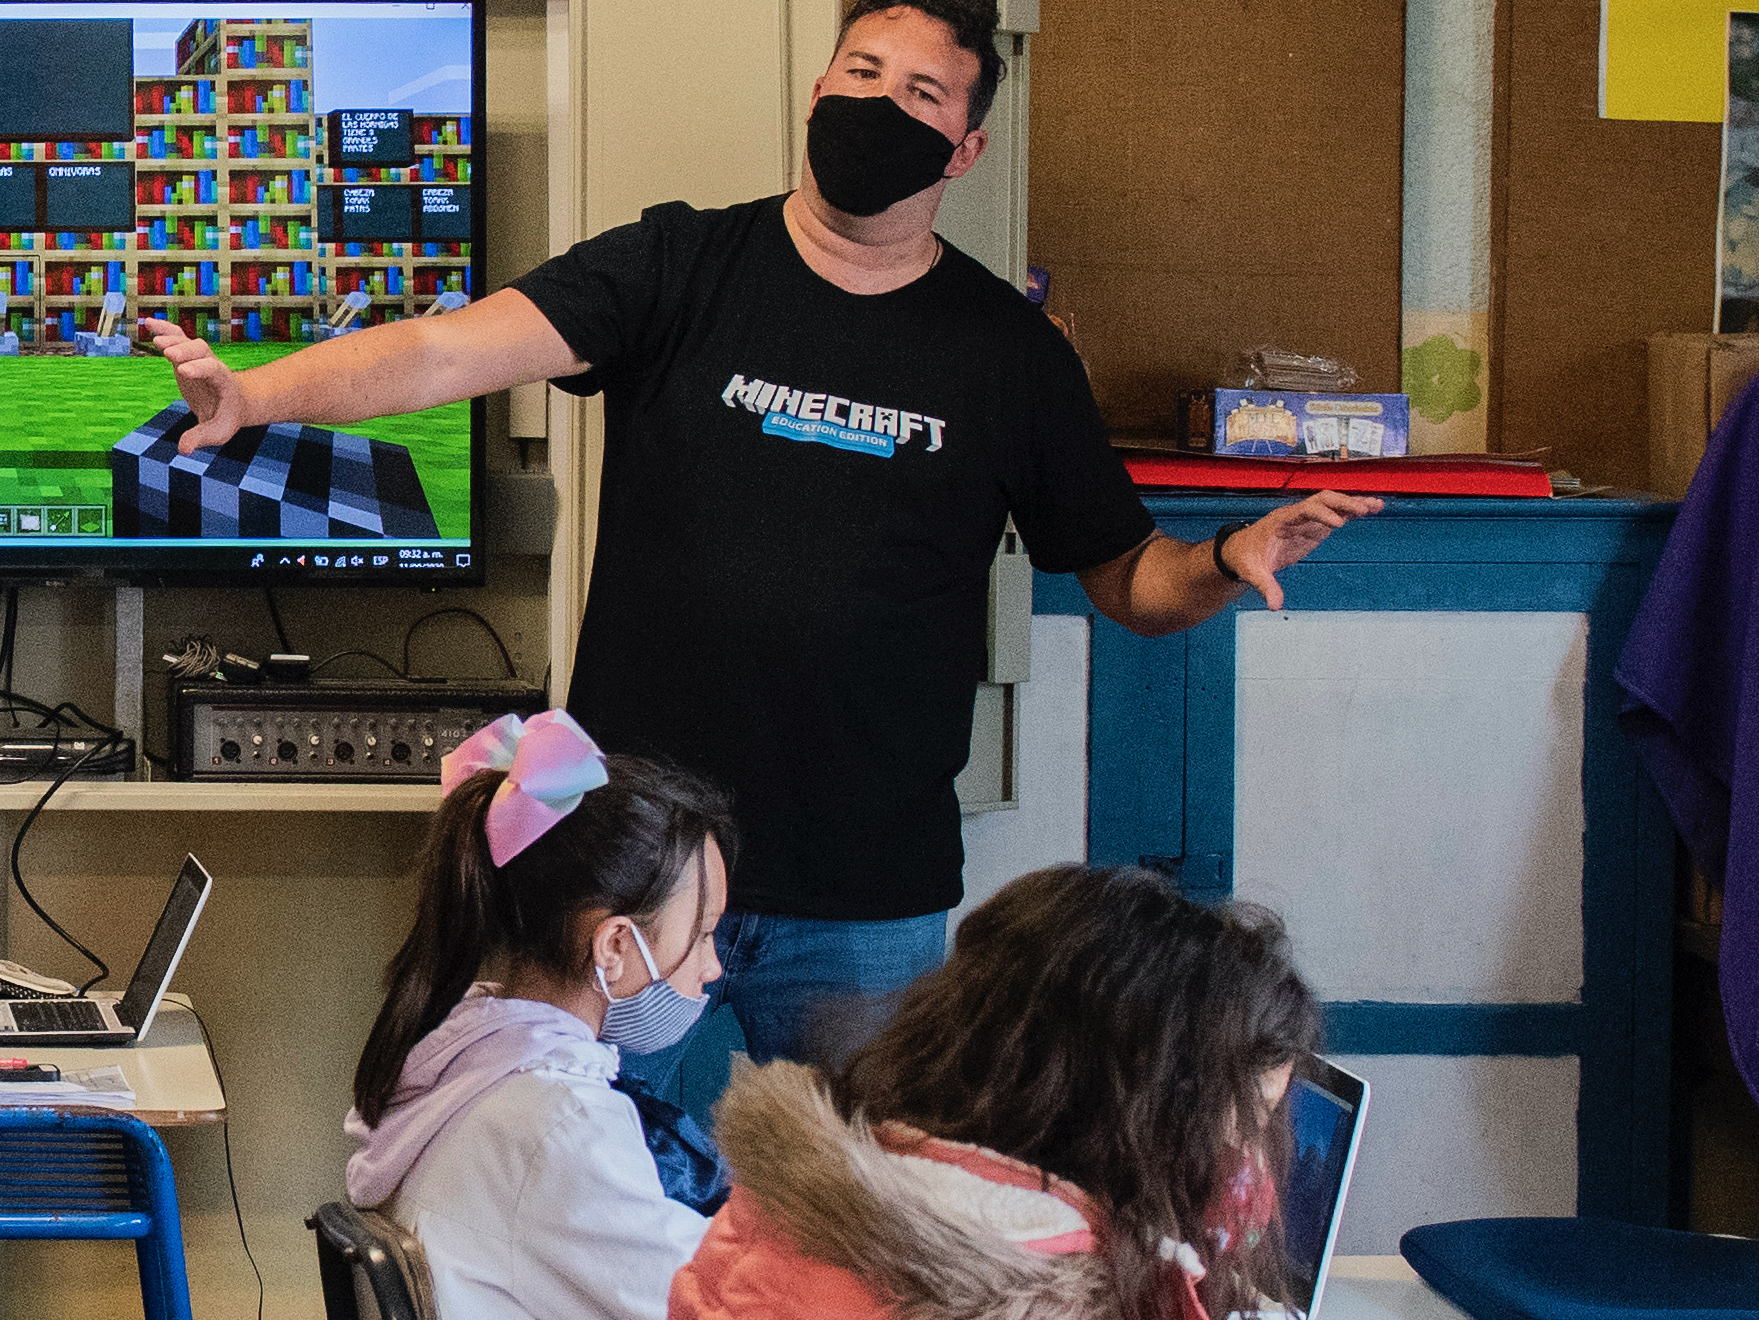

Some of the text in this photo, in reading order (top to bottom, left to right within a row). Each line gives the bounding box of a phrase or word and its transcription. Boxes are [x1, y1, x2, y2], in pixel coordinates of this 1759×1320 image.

[721, 373, 946, 452] MINECRAFT
[771, 415, 888, 447] EDUCATION EDITION
